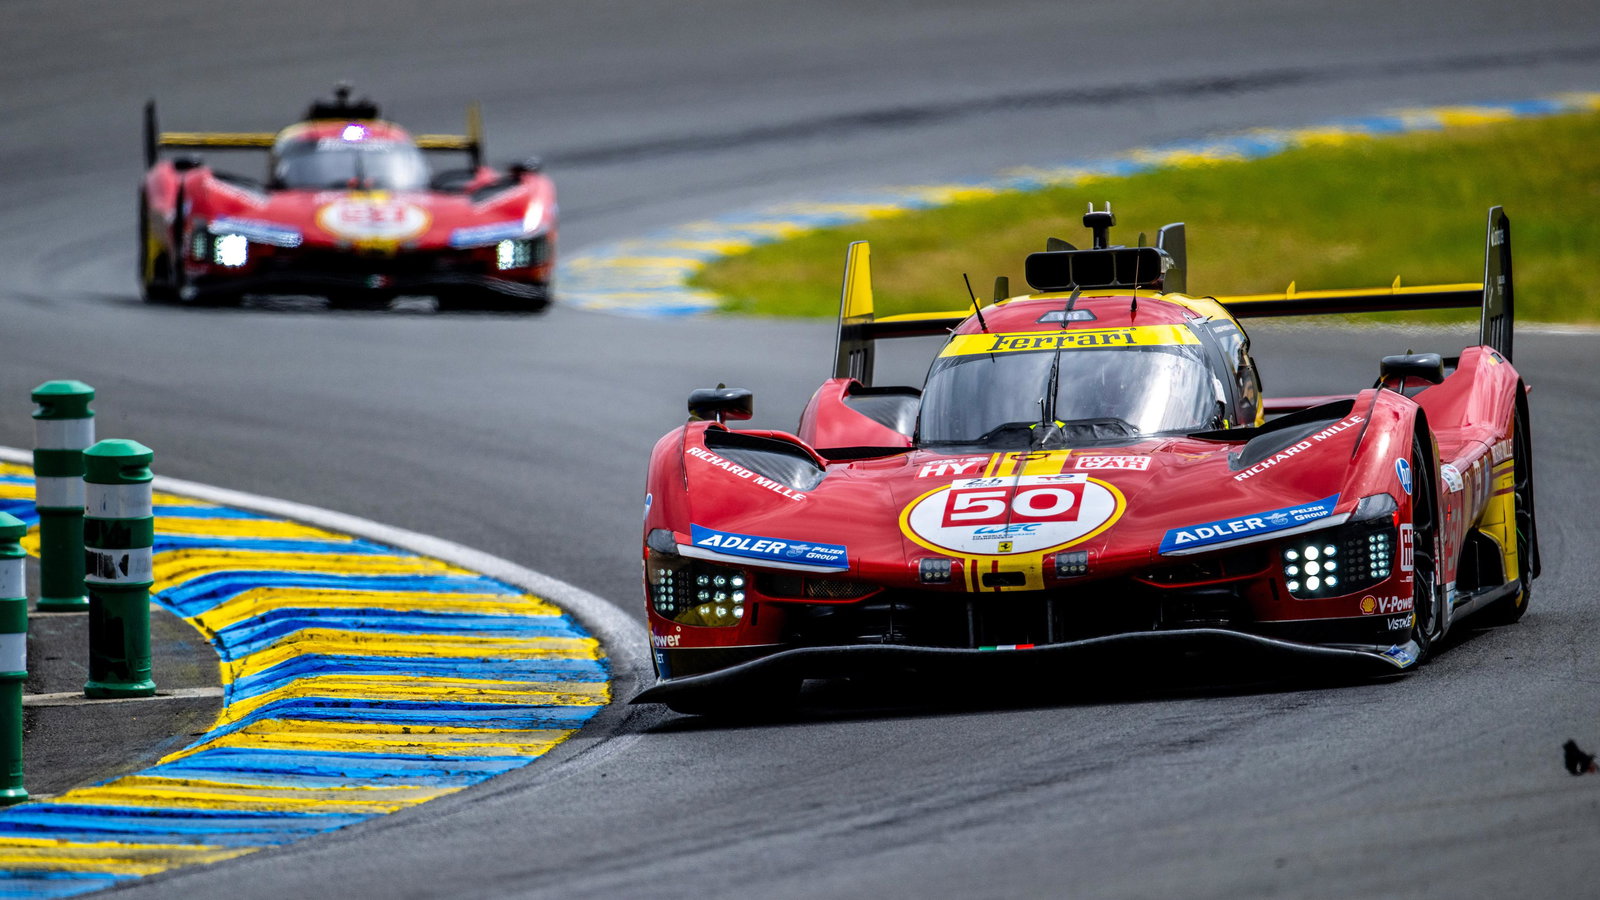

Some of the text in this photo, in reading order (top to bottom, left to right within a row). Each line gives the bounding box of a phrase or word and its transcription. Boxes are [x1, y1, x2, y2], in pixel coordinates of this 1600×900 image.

[986, 328, 1137, 352] Ferrari
[1233, 415, 1365, 482] RICHARD MILLE
[918, 461, 978, 478] HY
[1080, 460, 1144, 469] CAR
[686, 447, 807, 501] RICHARD MILLE
[950, 487, 1075, 521] 50
[1289, 505, 1325, 516] PELZER
[1294, 510, 1329, 521] GROUP
[973, 523, 1042, 534] WEC
[1174, 517, 1267, 545] ADLER
[697, 534, 787, 554] ADLER
[812, 546, 845, 555] PELZER
[806, 552, 839, 561] GROUP
[1378, 596, 1414, 614] V-Powe
